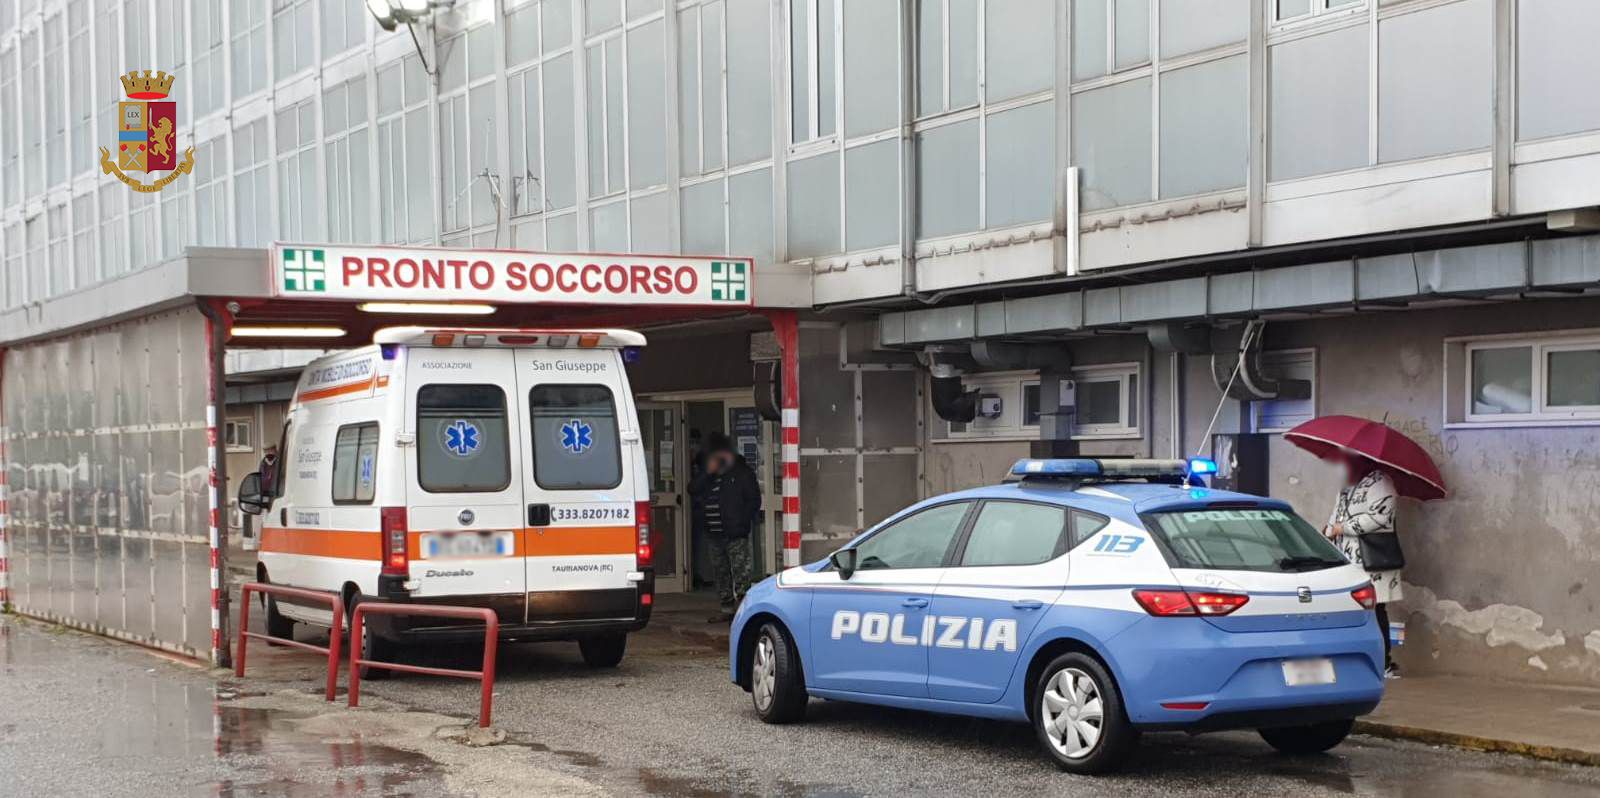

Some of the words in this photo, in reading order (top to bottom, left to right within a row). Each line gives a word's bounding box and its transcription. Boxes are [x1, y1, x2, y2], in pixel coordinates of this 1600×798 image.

[341, 256, 495, 292] PRONTO
[505, 262, 699, 295] SOCCORSO
[422, 361, 473, 370] ASSOCIAZIONE
[532, 360, 553, 371] San
[555, 360, 607, 374] Giuseppe
[557, 508, 630, 520] 333.8207182
[1184, 511, 1291, 523] POLIZIA
[1093, 534, 1145, 553] 113
[425, 569, 475, 578] Ducato
[831, 609, 1018, 652] POLIZIA
